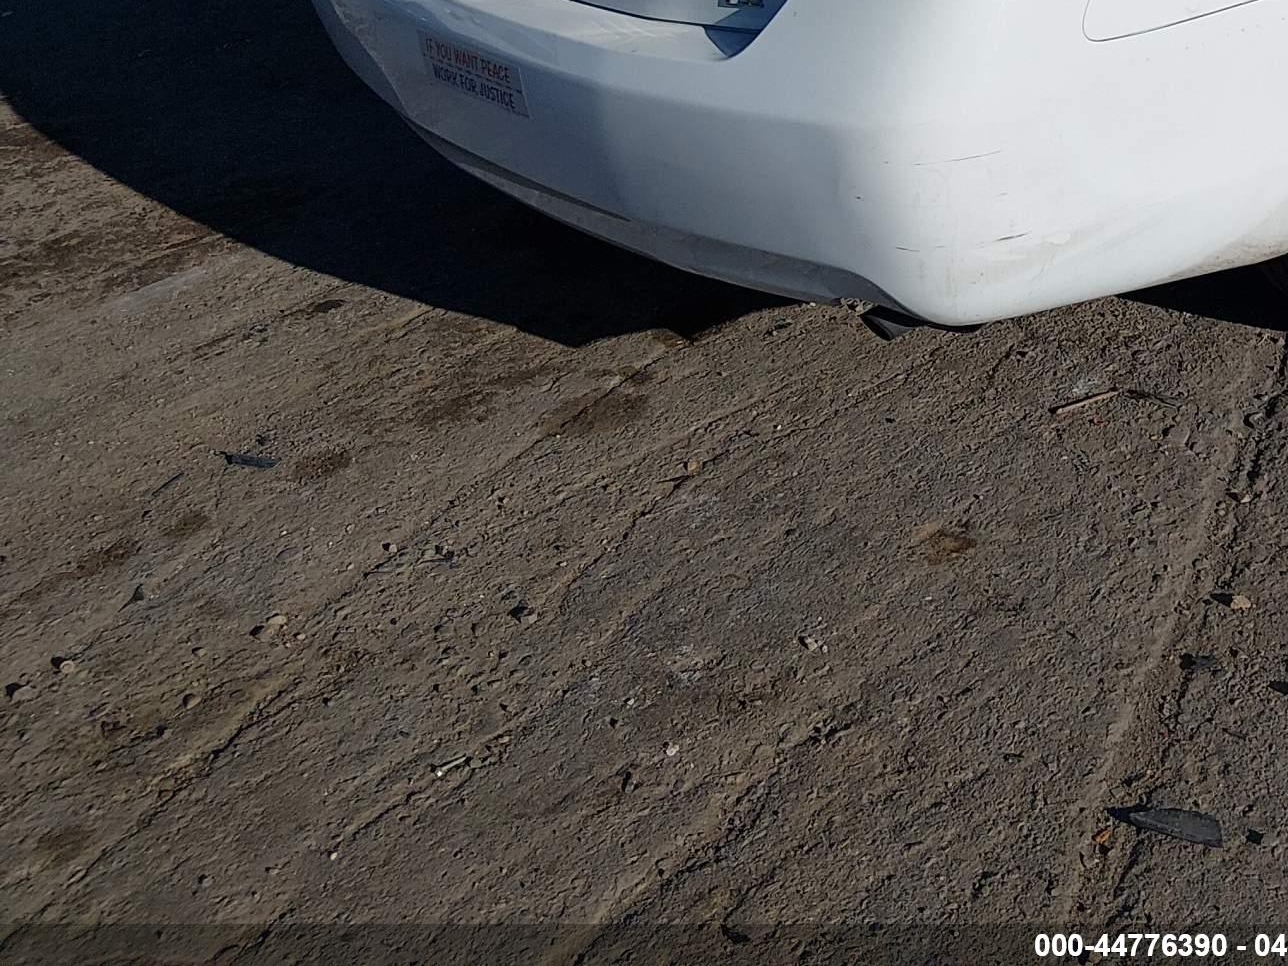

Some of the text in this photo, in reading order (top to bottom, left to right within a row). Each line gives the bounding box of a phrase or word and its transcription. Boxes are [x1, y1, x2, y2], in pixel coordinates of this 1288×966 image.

[425, 38, 511, 84] IF YOU WANT PEACE
[432, 63, 516, 110] WORK FOR JUSTICE
